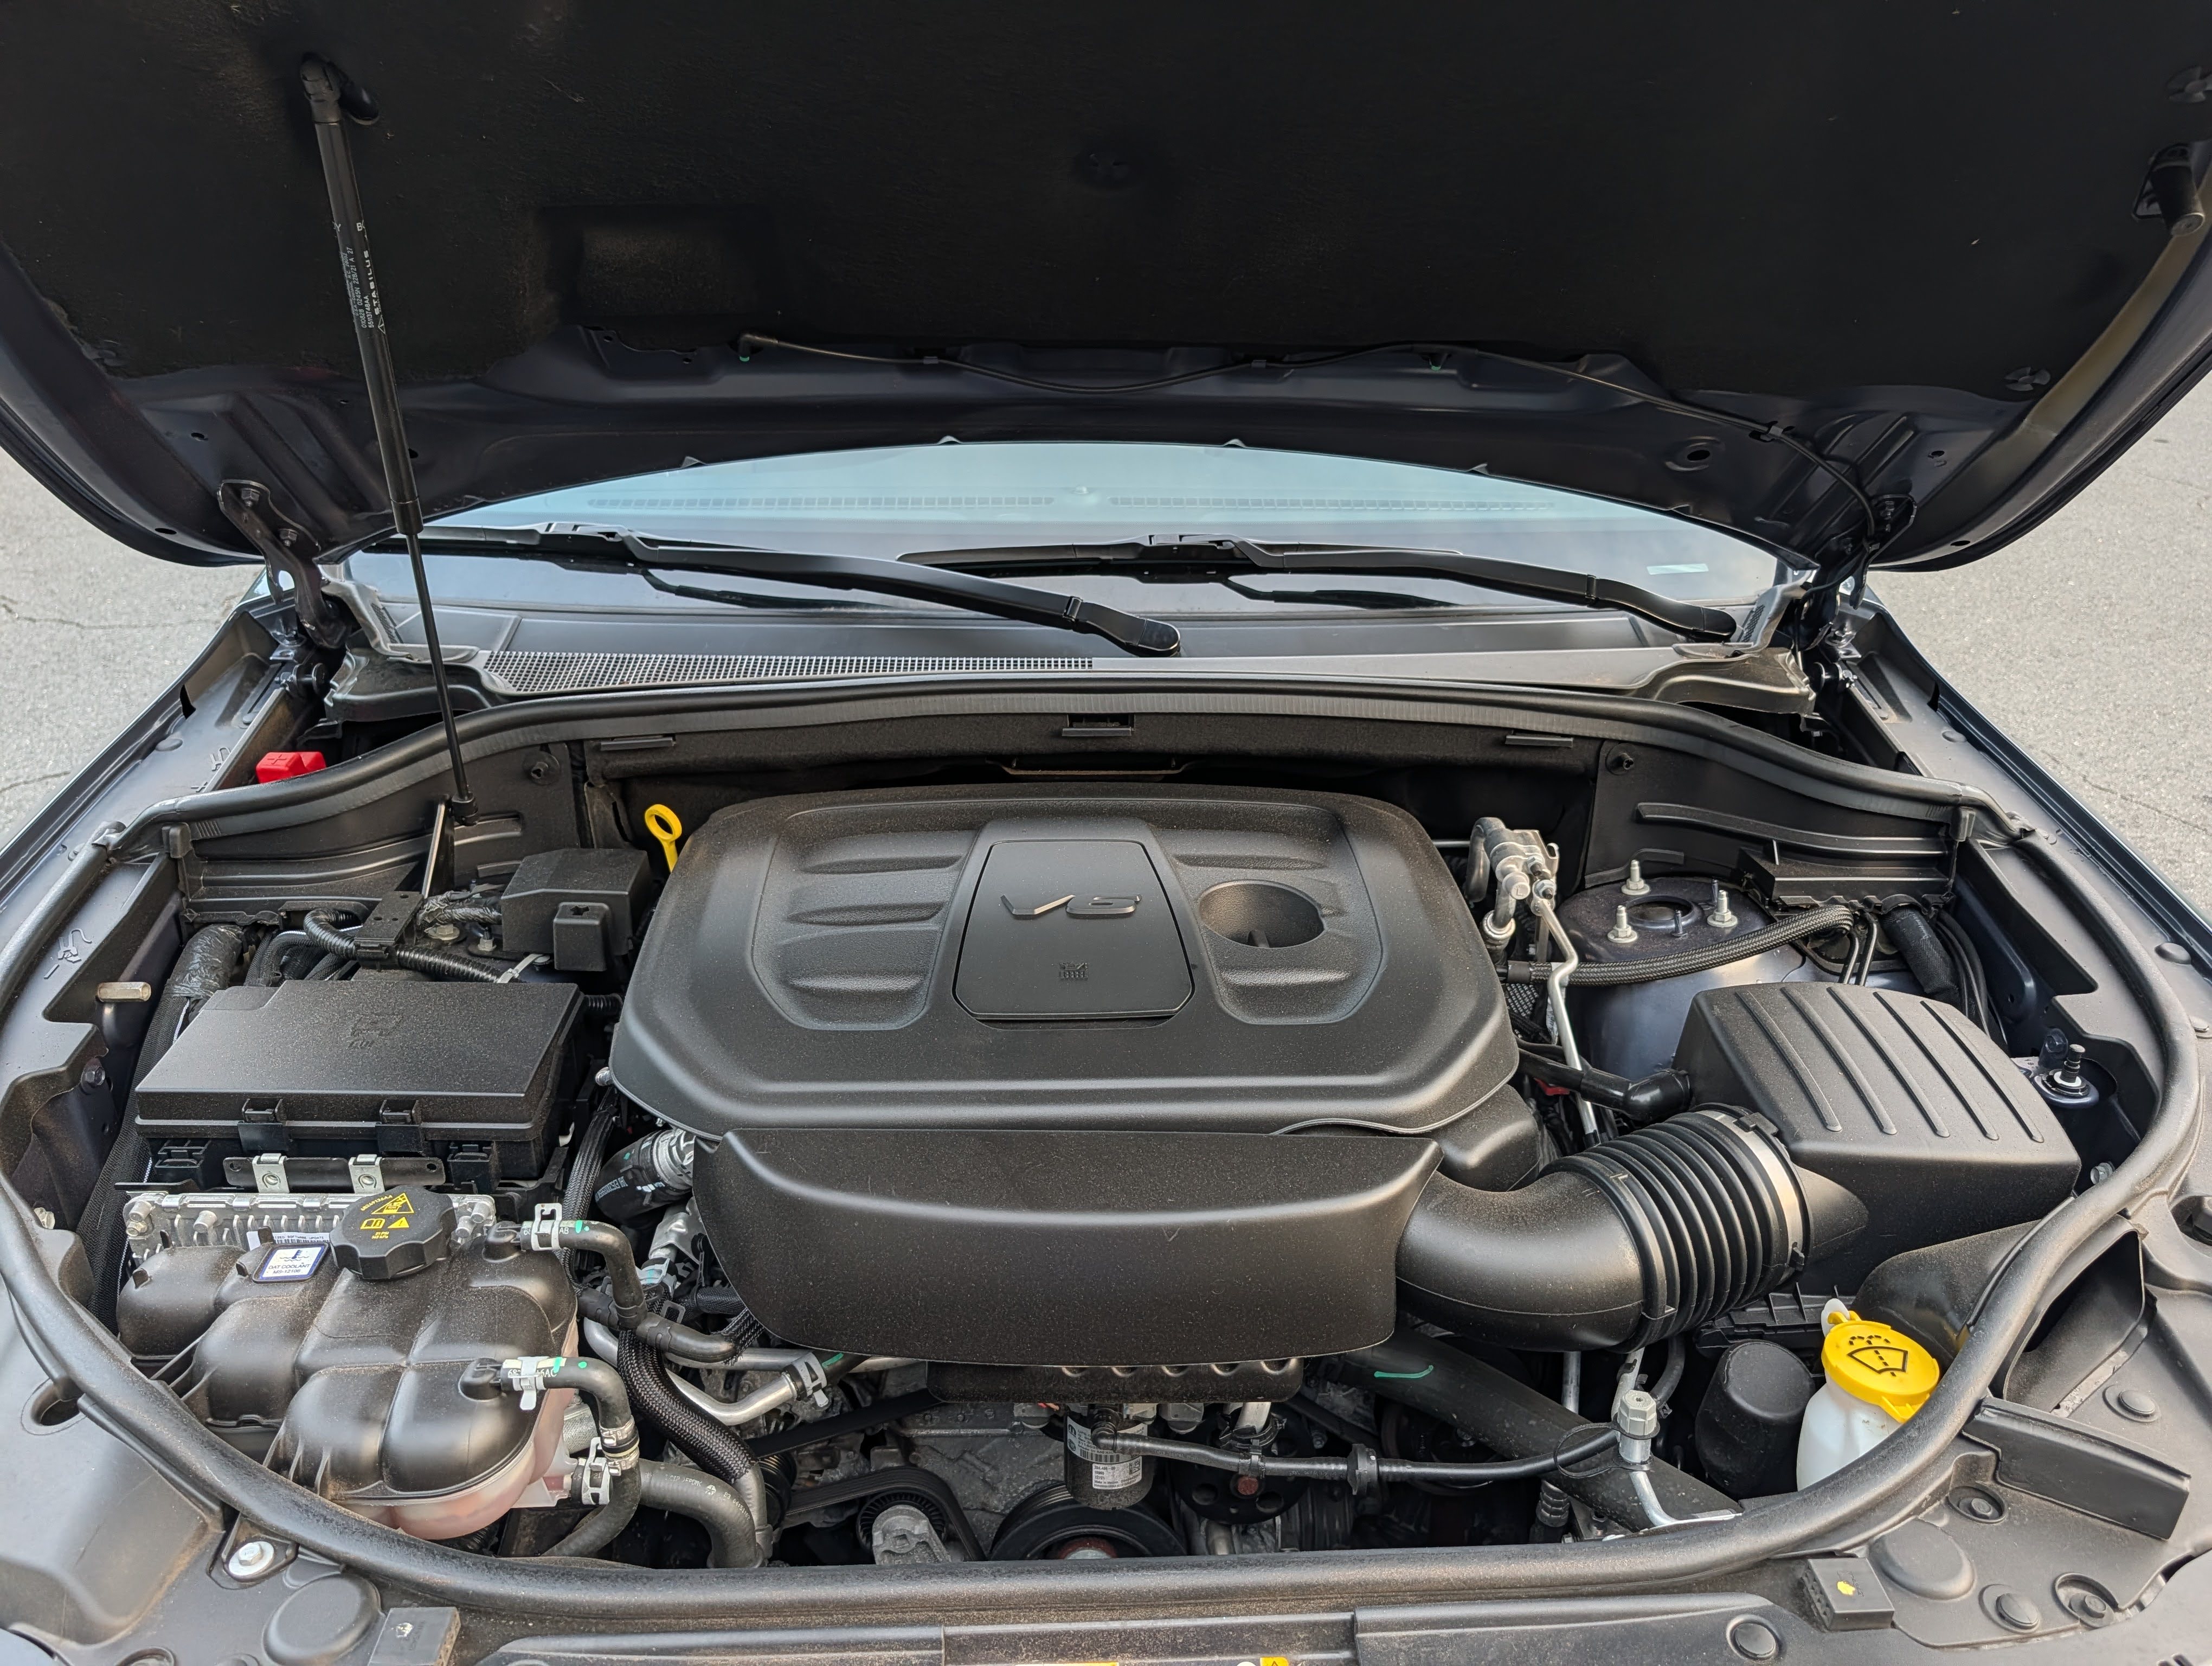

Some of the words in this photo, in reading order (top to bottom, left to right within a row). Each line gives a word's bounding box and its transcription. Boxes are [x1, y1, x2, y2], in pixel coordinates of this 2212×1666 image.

[346, 246, 354, 255] 27
[350, 265, 359, 285] 228/21
[363, 250, 380, 316] STABILUS
[355, 287, 363, 306] 0245N
[358, 309, 367, 329] 010828
[363, 295, 375, 329] 55113748AA
